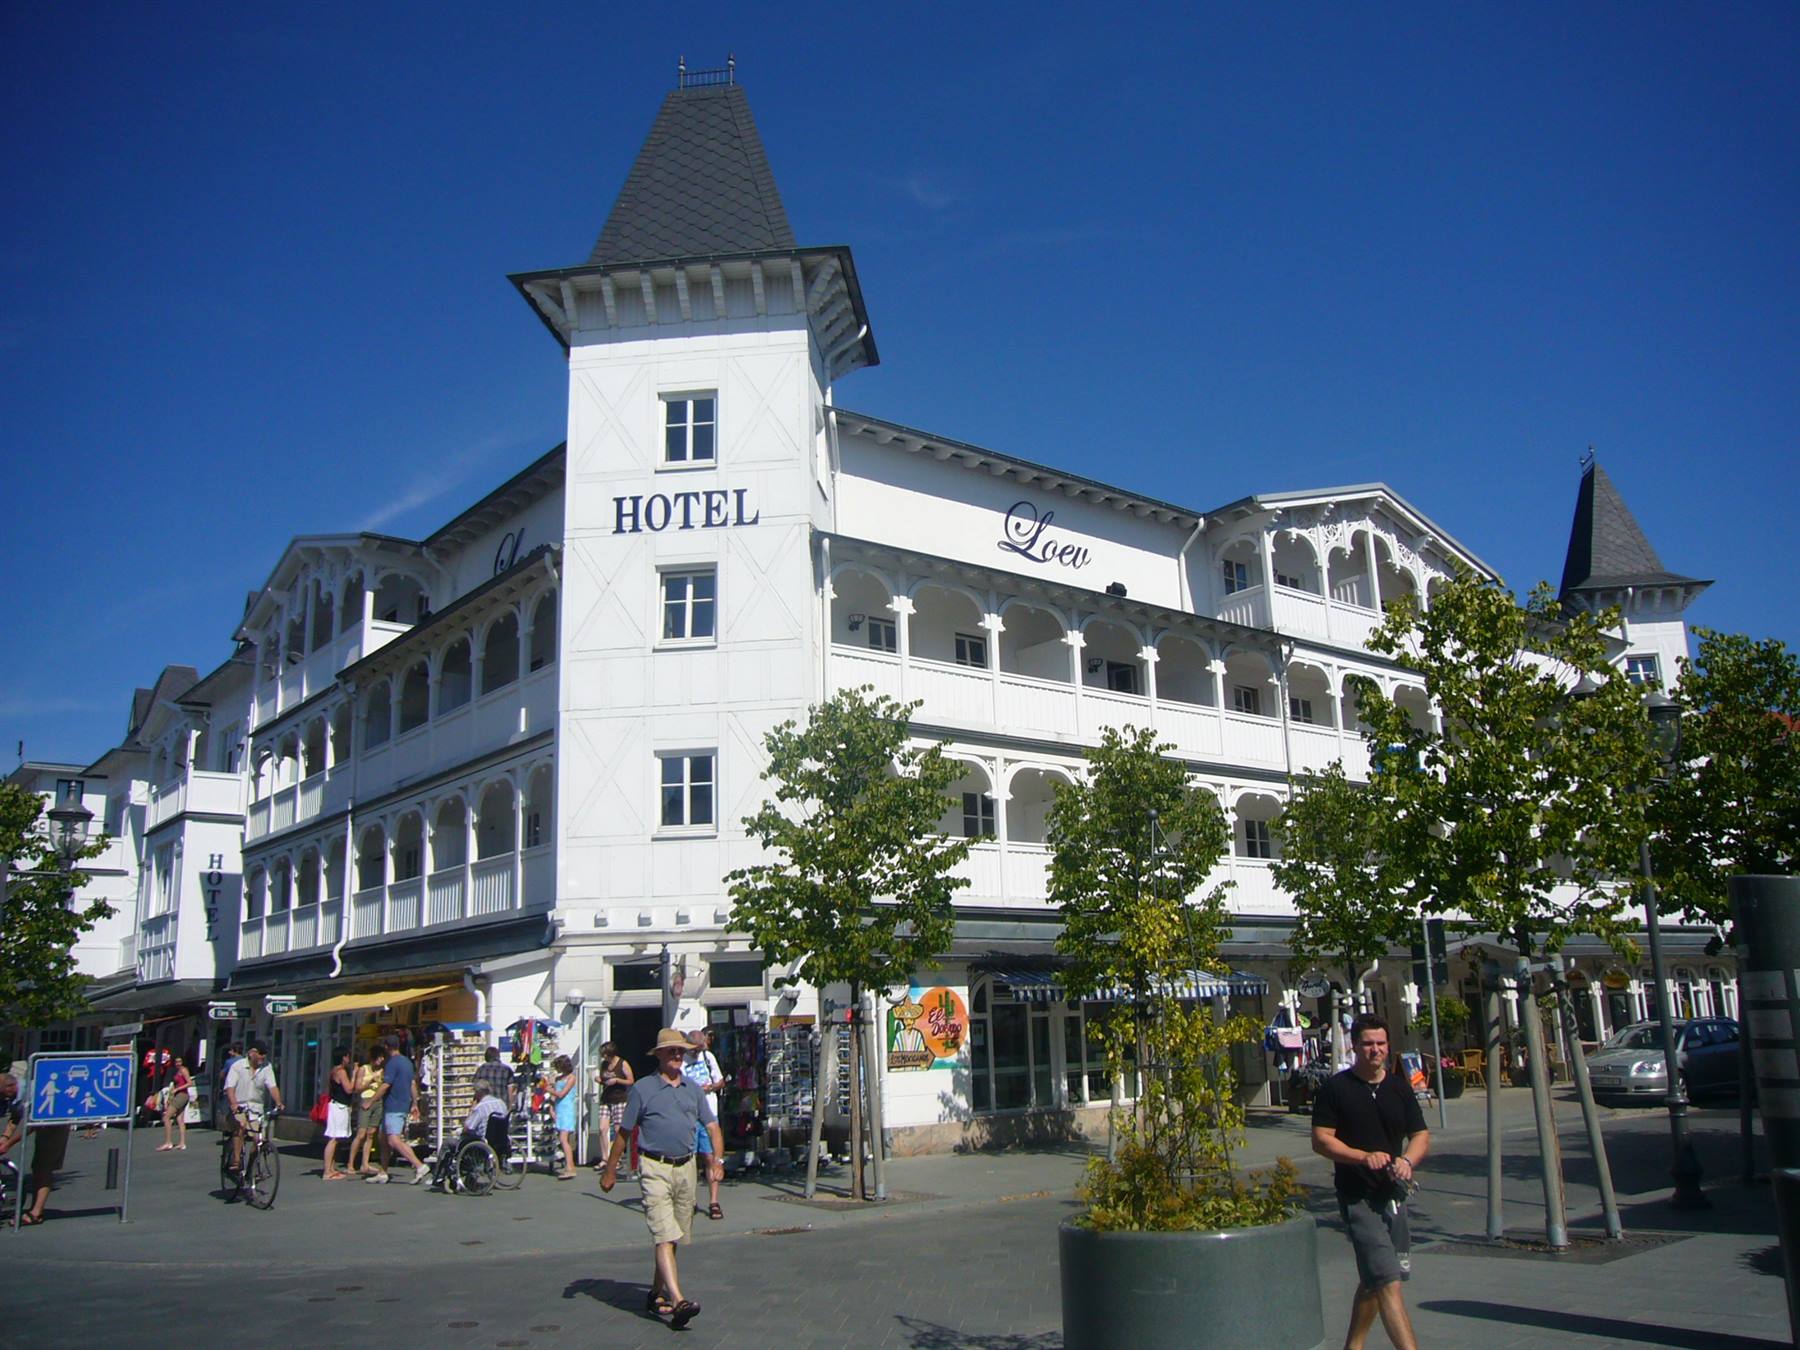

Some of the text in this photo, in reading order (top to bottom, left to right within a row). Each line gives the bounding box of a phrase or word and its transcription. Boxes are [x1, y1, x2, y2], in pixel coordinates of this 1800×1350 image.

[612, 488, 759, 534] HOTEL
[997, 501, 1092, 569] Loev
[205, 853, 224, 942] HOTEL
[928, 1006, 945, 1024] El
